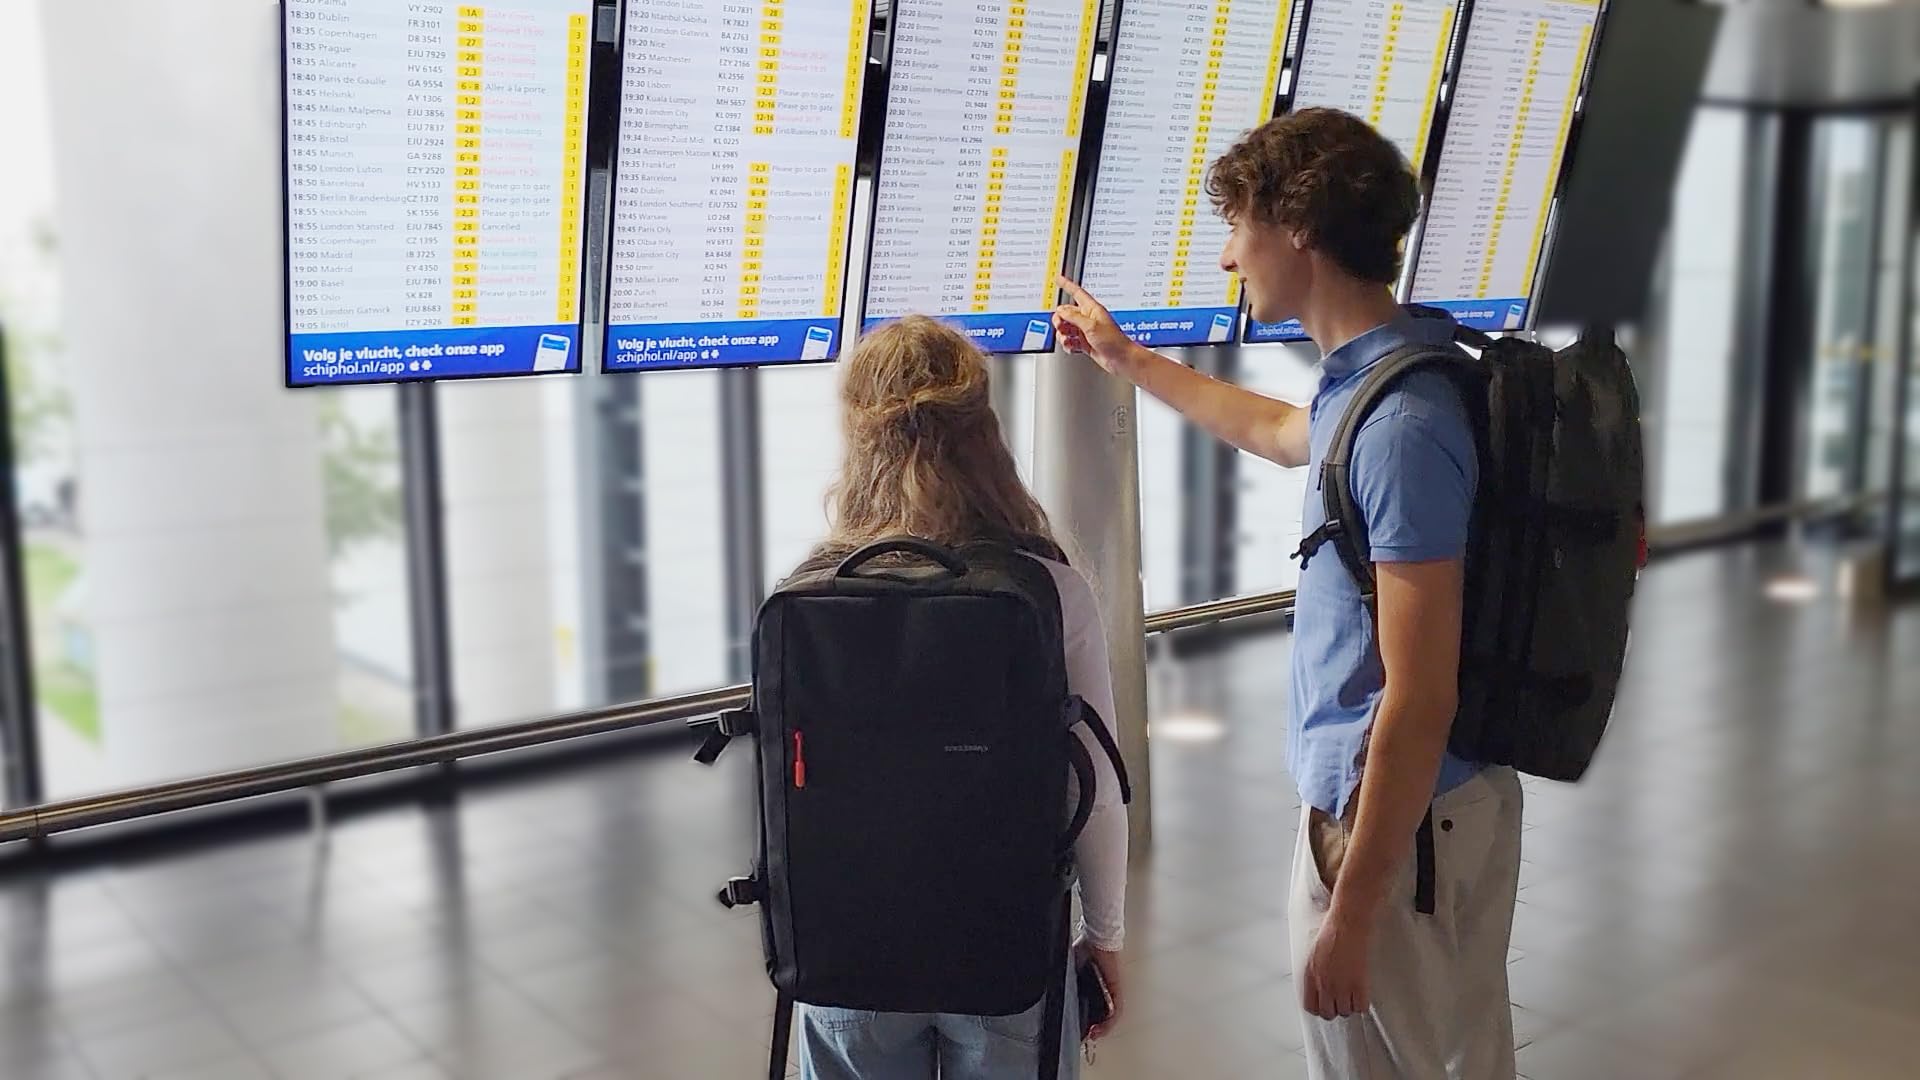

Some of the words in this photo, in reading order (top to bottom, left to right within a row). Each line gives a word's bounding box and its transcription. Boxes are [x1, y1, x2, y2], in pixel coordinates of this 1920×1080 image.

[423, 4, 443, 14] 2902
[629, 10, 649, 19] 19:20
[290, 10, 316, 20] 18:30
[318, 11, 350, 23] Dublin
[420, 20, 440, 29] 3101
[466, 24, 477, 32] 30
[291, 26, 316, 35] 18:35
[318, 27, 377, 40] Copenhagen
[628, 24, 649, 33] 19:20
[628, 38, 648, 46] 19:20
[291, 42, 316, 51] 18:35
[318, 44, 351, 54] Prague
[425, 50, 446, 59] 7929
[627, 52, 647, 60] 19:25
[291, 57, 316, 66] 18:35
[408, 64, 421, 73] HV
[422, 65, 443, 73] 6145
[626, 66, 646, 74] 19:25
[291, 73, 316, 81] 18:40
[319, 74, 341, 84] Paris
[343, 75, 355, 84] de
[423, 80, 443, 88] 9554
[292, 88, 316, 97] 18:45
[423, 94, 442, 103] 1306
[625, 93, 644, 101] 19:30
[292, 104, 317, 112] 18:45
[624, 107, 643, 115] 19:30
[292, 119, 317, 128] 18:45
[293, 134, 317, 142] 18:45
[319, 134, 349, 143] Bristol
[424, 138, 444, 147] 2924
[293, 149, 317, 157] 18:45
[293, 164, 317, 172] 18:50
[320, 164, 354, 173] London
[293, 178, 317, 186] 18:50
[293, 193, 317, 201] 18:50
[293, 208, 317, 216] 18:55
[294, 237, 318, 245] 18:55
[1137, 320, 1160, 330] check
[1159, 321, 1179, 329] onze
[1179, 321, 1194, 331] app
[964, 328, 986, 337] onze
[987, 327, 1005, 339] app
[617, 338, 644, 352] Volg
[645, 338, 656, 351] je
[658, 336, 696, 348] vlucht,
[698, 334, 729, 347] check
[731, 336, 756, 346] onze
[758, 335, 779, 347] app
[303, 349, 337, 363] Volg
[339, 348, 353, 363] je
[355, 346, 402, 360] vlucht,
[405, 344, 443, 358] check
[445, 345, 477, 356] onze
[479, 343, 505, 356] app
[616, 351, 697, 364] schiphol.nl/app
[303, 360, 404, 377] schiphol.nl/app
